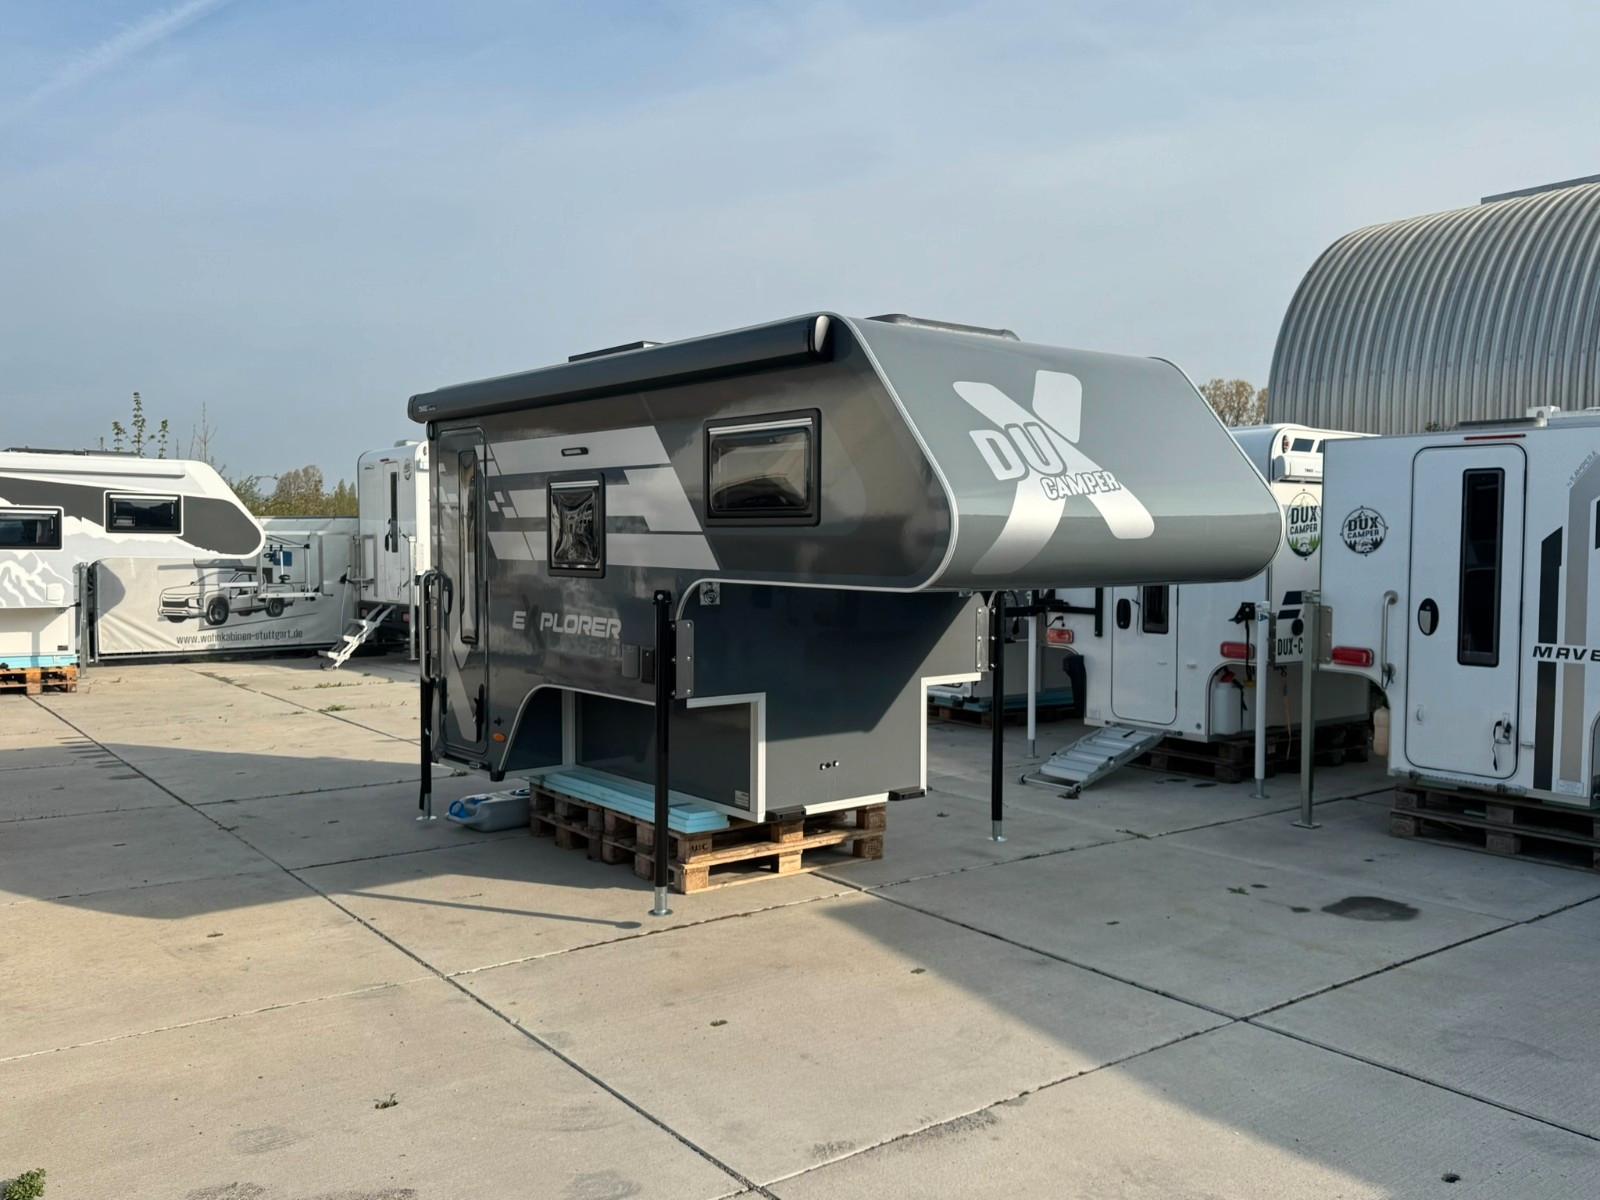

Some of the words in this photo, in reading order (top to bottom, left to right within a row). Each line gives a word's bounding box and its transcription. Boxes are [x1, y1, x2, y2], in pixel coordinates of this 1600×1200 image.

[1040, 471, 1121, 500] CAMPER
[1291, 505, 1317, 524] DUX
[1290, 523, 1318, 535] CAMPER
[1348, 516, 1379, 531] DUX
[1347, 529, 1379, 539] CAMPER
[176, 629, 303, 644] www.wohnkabinen-stuttgart.de
